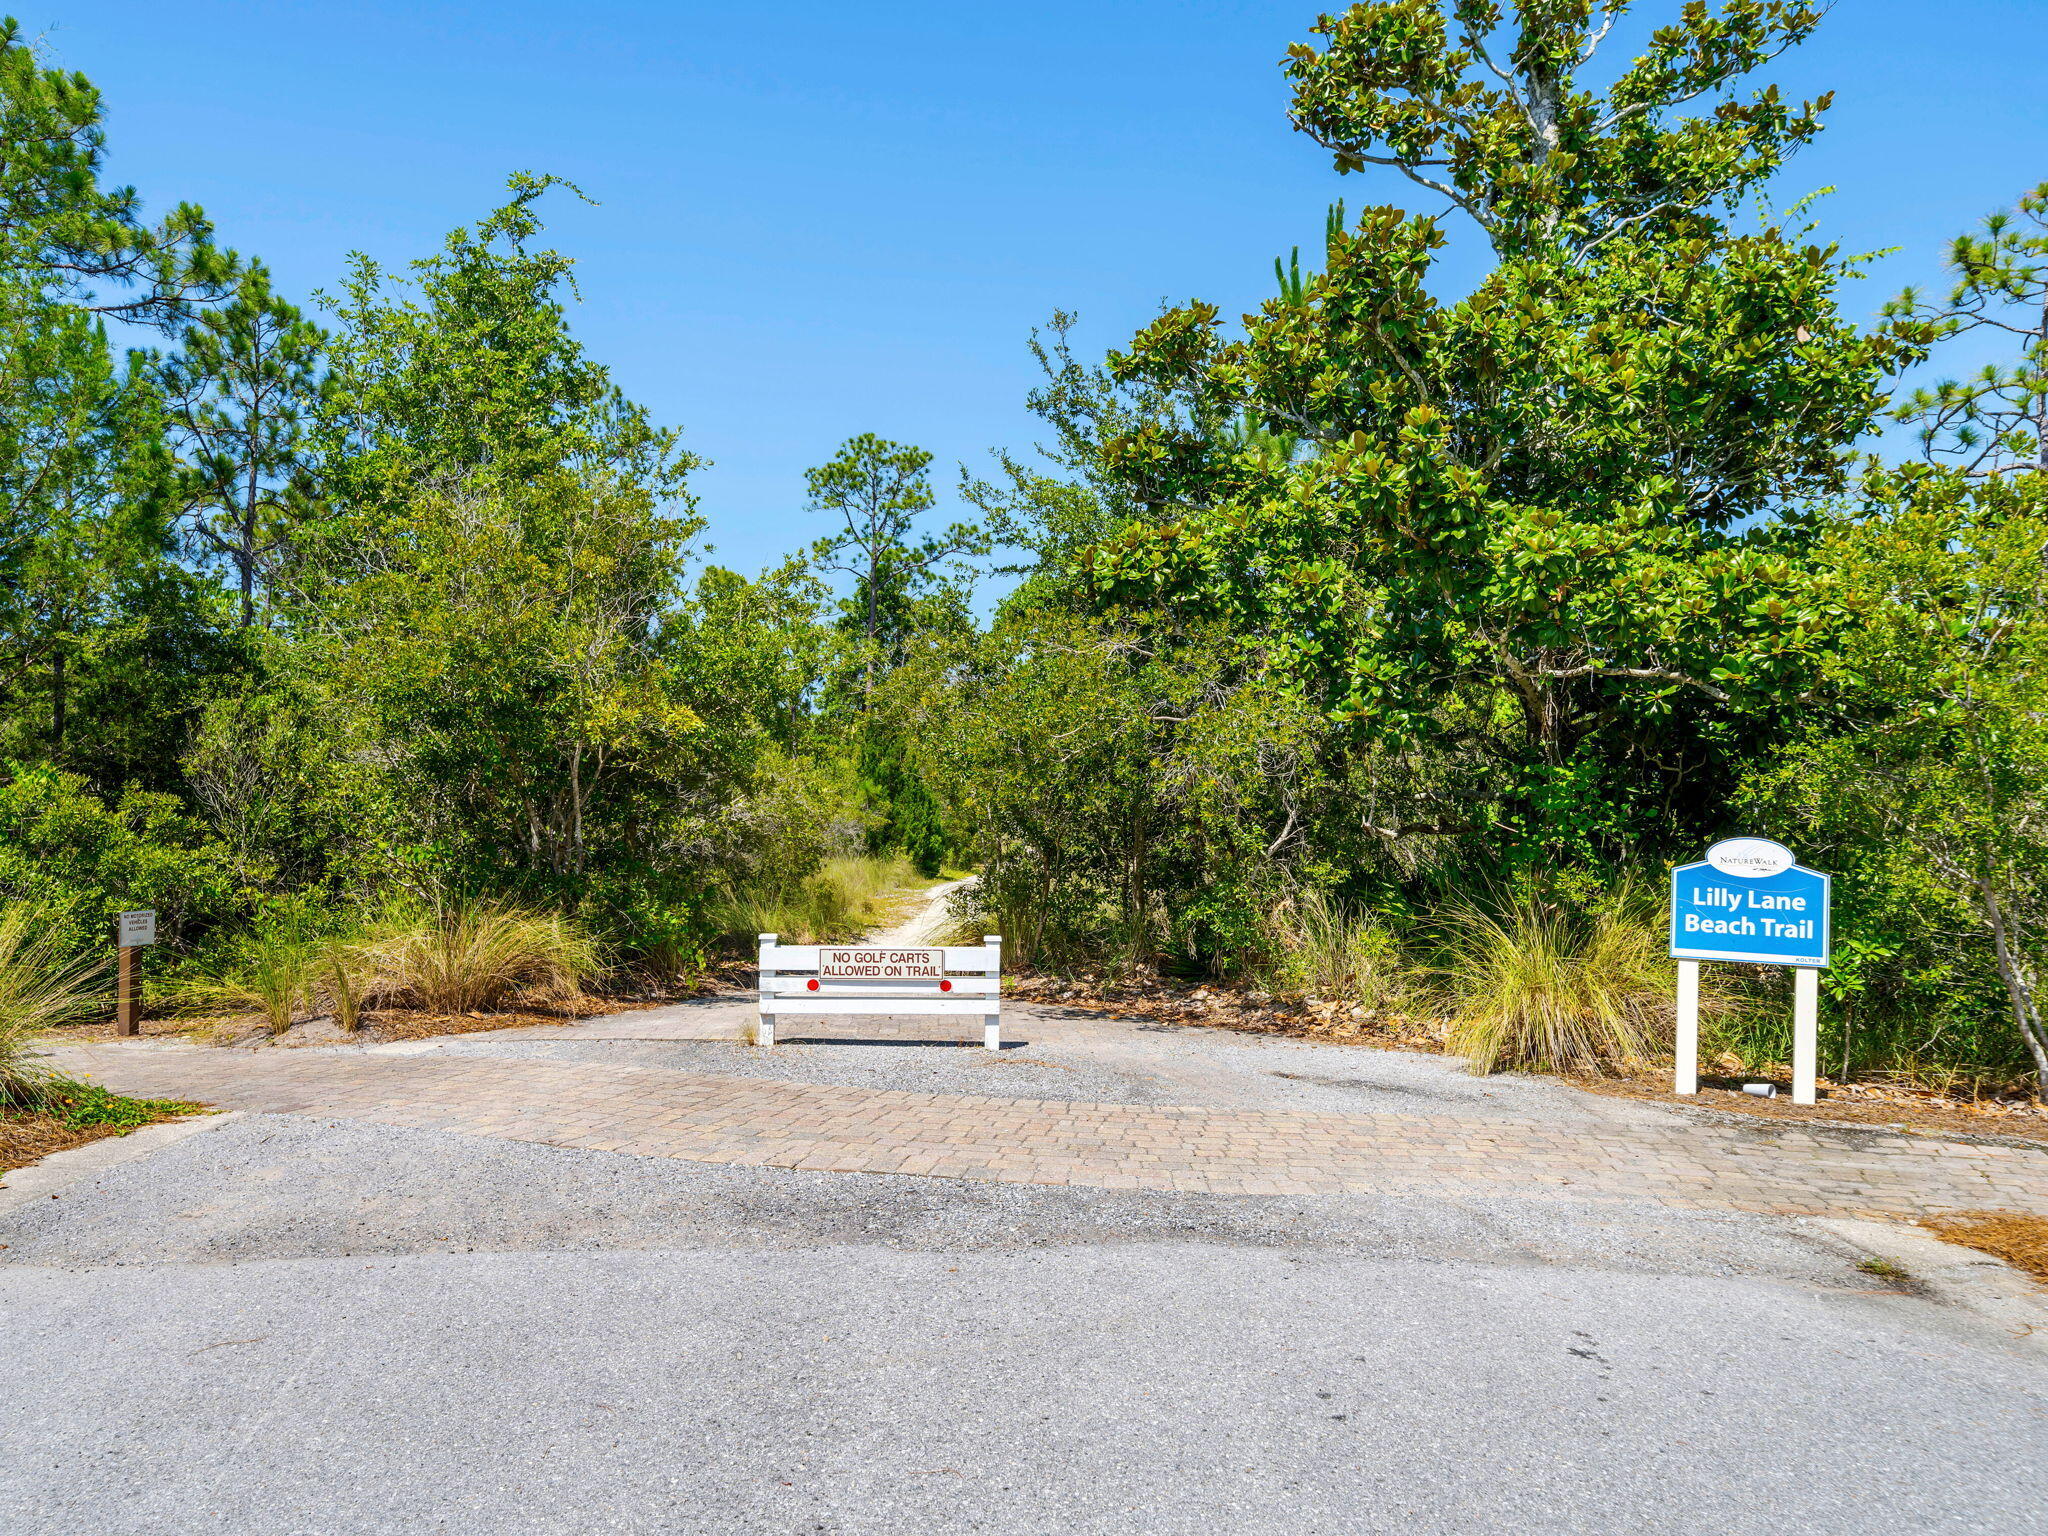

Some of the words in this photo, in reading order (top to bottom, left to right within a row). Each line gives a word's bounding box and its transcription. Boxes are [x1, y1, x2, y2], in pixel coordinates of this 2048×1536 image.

[1693, 887, 1742, 912] Lilly
[1748, 890, 1806, 911] Lane
[1685, 914, 1756, 936] Beach
[1760, 918, 1813, 939] Trail
[833, 952, 851, 964] NO
[854, 952, 886, 964] GOLF
[889, 952, 930, 964] CARTS
[823, 965, 880, 976] ALLOWED
[884, 966, 902, 976] ON
[906, 966, 940, 977] TRAIL
